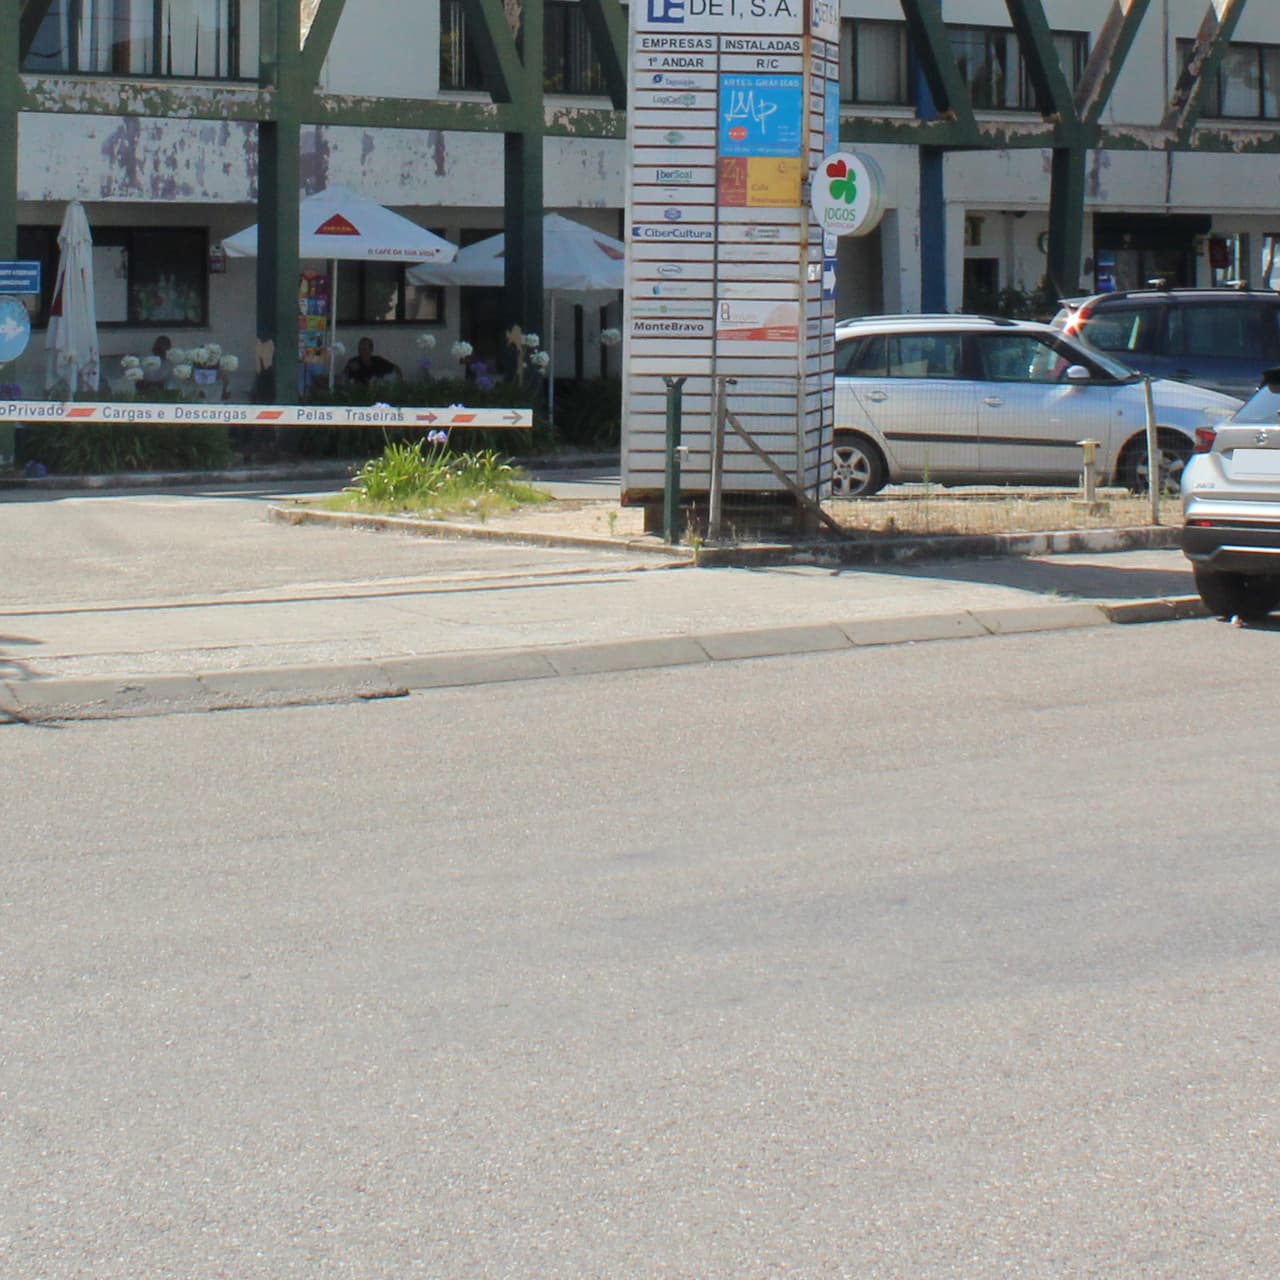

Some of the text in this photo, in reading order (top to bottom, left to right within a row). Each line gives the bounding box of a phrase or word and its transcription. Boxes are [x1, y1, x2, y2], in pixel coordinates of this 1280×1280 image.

[642, 38, 712, 49] EMPRESAS
[725, 39, 800, 51] INSTALADAS
[662, 57, 704, 68] ANDAR
[756, 58, 779, 69] R/C
[824, 208, 856, 223] JOGOS
[644, 227, 712, 238] CiberCultura
[634, 321, 704, 332] MonteBravo
[102, 406, 153, 421] Cargas
[157, 409, 165, 419] e
[174, 407, 248, 422] Descargas
[297, 408, 333, 421] Pelas
[345, 408, 404, 422] Traseiras
